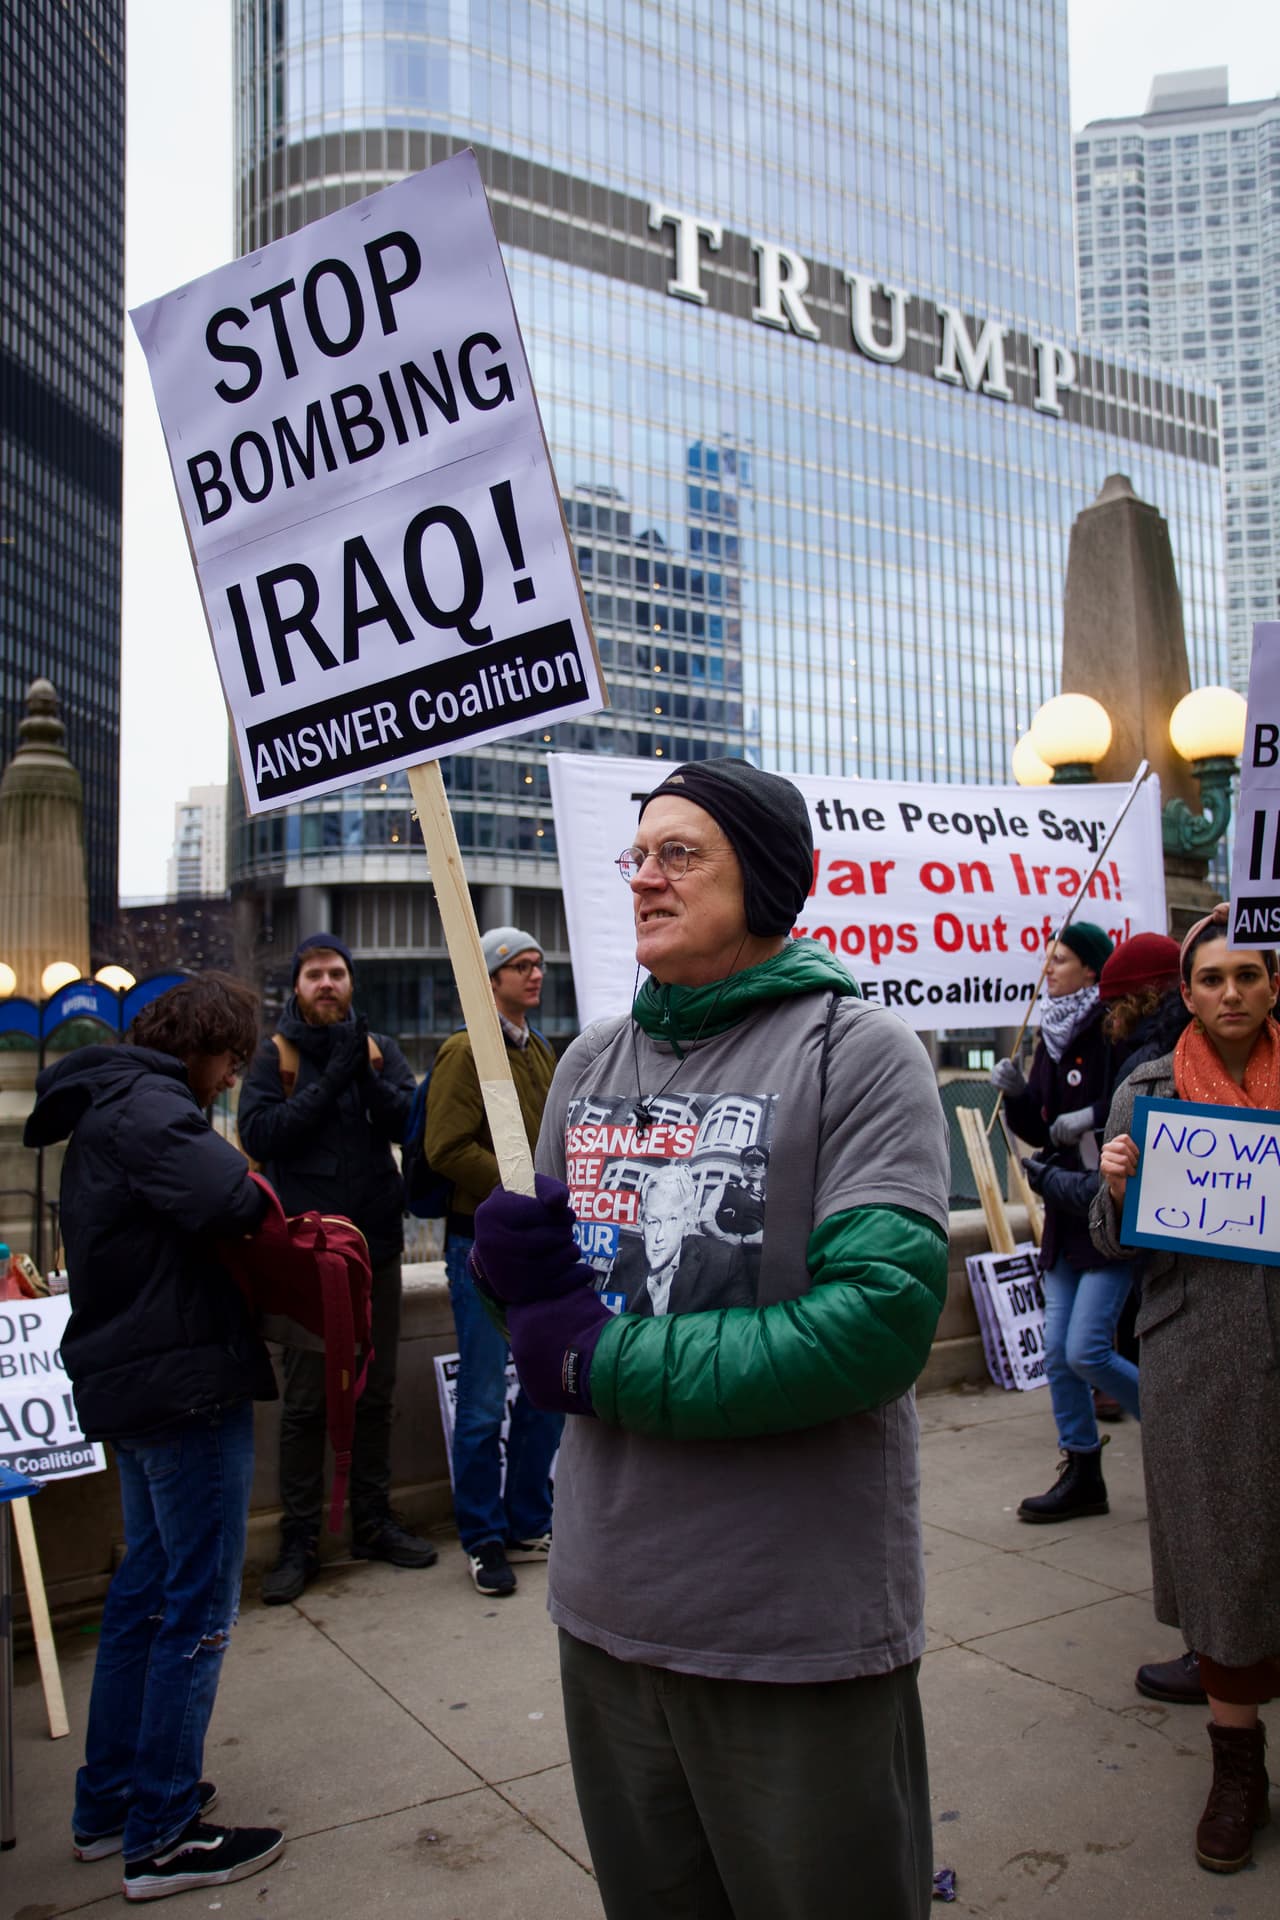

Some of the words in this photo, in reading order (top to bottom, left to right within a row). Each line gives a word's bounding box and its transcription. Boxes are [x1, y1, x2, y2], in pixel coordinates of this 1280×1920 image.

[205, 230, 422, 404] STOP
[649, 202, 1077, 417] TRUMP
[186, 331, 515, 525] BOMBING
[226, 480, 536, 697] IRAQ!
[255, 700, 403, 784] ANSWER
[408, 648, 582, 733] Coalition
[815, 799, 886, 831] the
[899, 802, 1029, 844] People
[1037, 809, 1106, 852] Say:
[919, 861, 994, 894] on
[1009, 853, 1123, 901] Iran!
[933, 913, 1007, 953] Out
[1152, 1122, 1217, 1158] NO
[1186, 1169, 1252, 1190] WITH
[1155, 1195, 1266, 1236] ایران
[15, 1448, 95, 1473] Coalition
